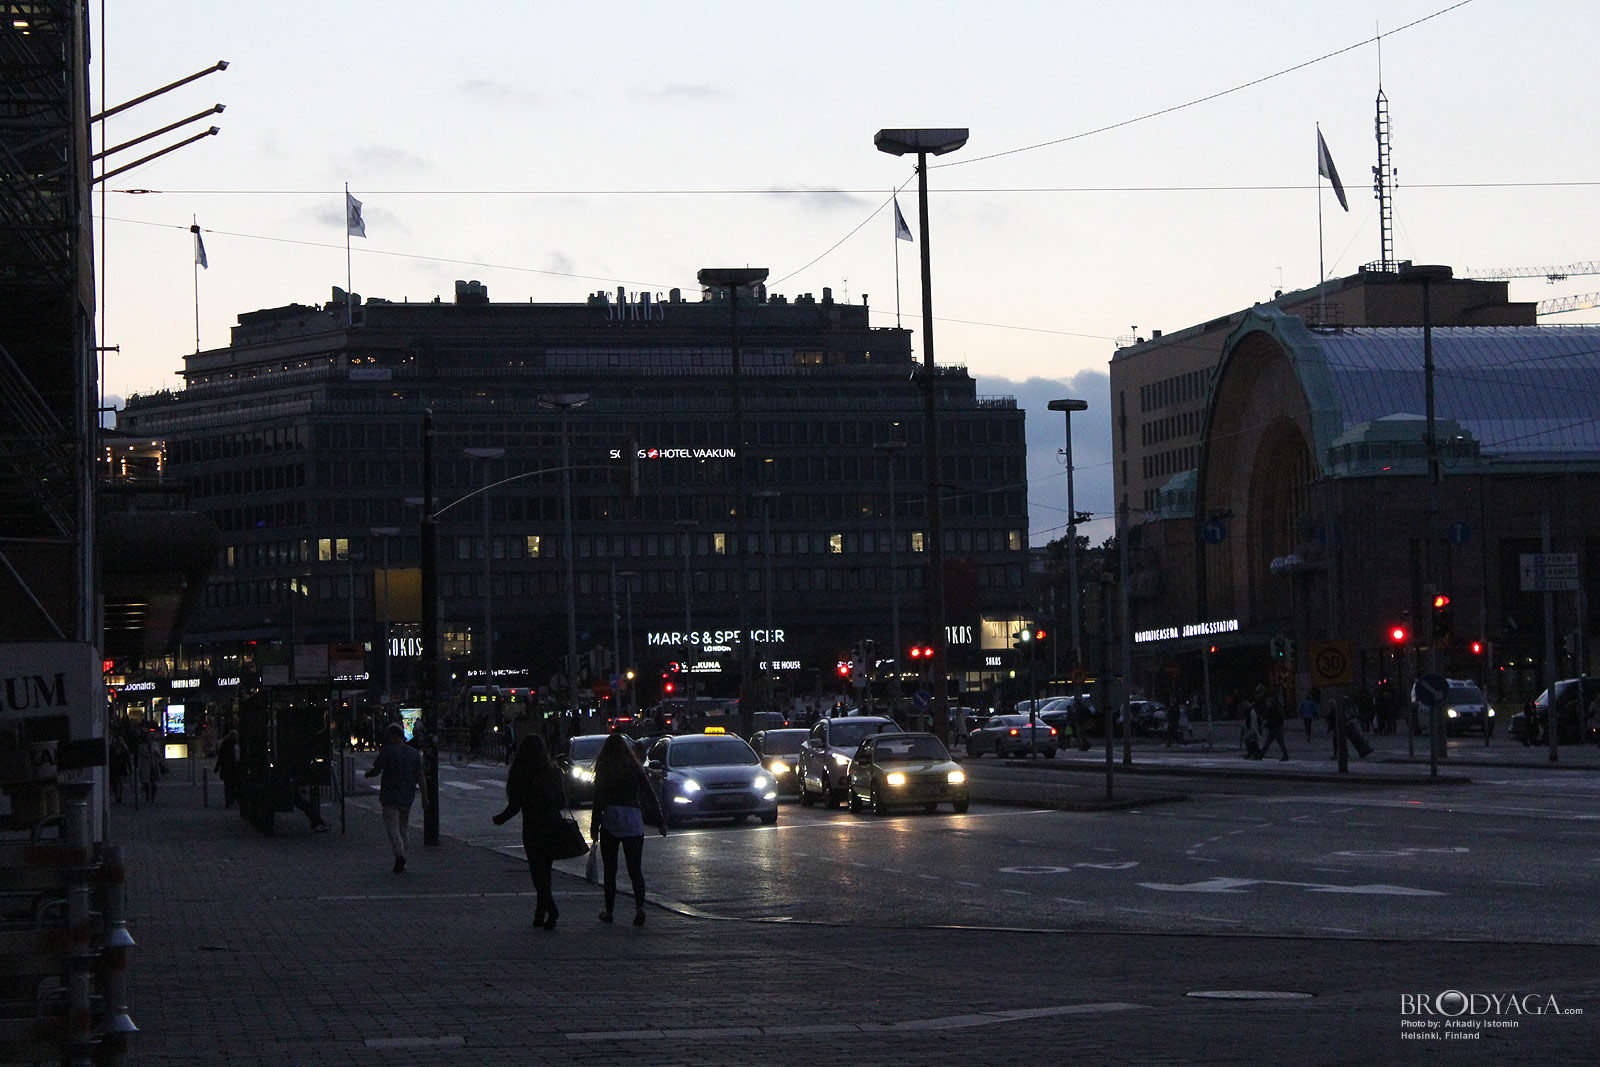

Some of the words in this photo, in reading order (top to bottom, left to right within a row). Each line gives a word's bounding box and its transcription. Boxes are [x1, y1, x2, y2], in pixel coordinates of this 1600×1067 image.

[659, 449, 692, 458] HOTEL
[702, 631, 713, 645] &
[1321, 655, 1339, 672] 30
[0, 672, 68, 712] UM
[117, 681, 156, 692] Donald's
